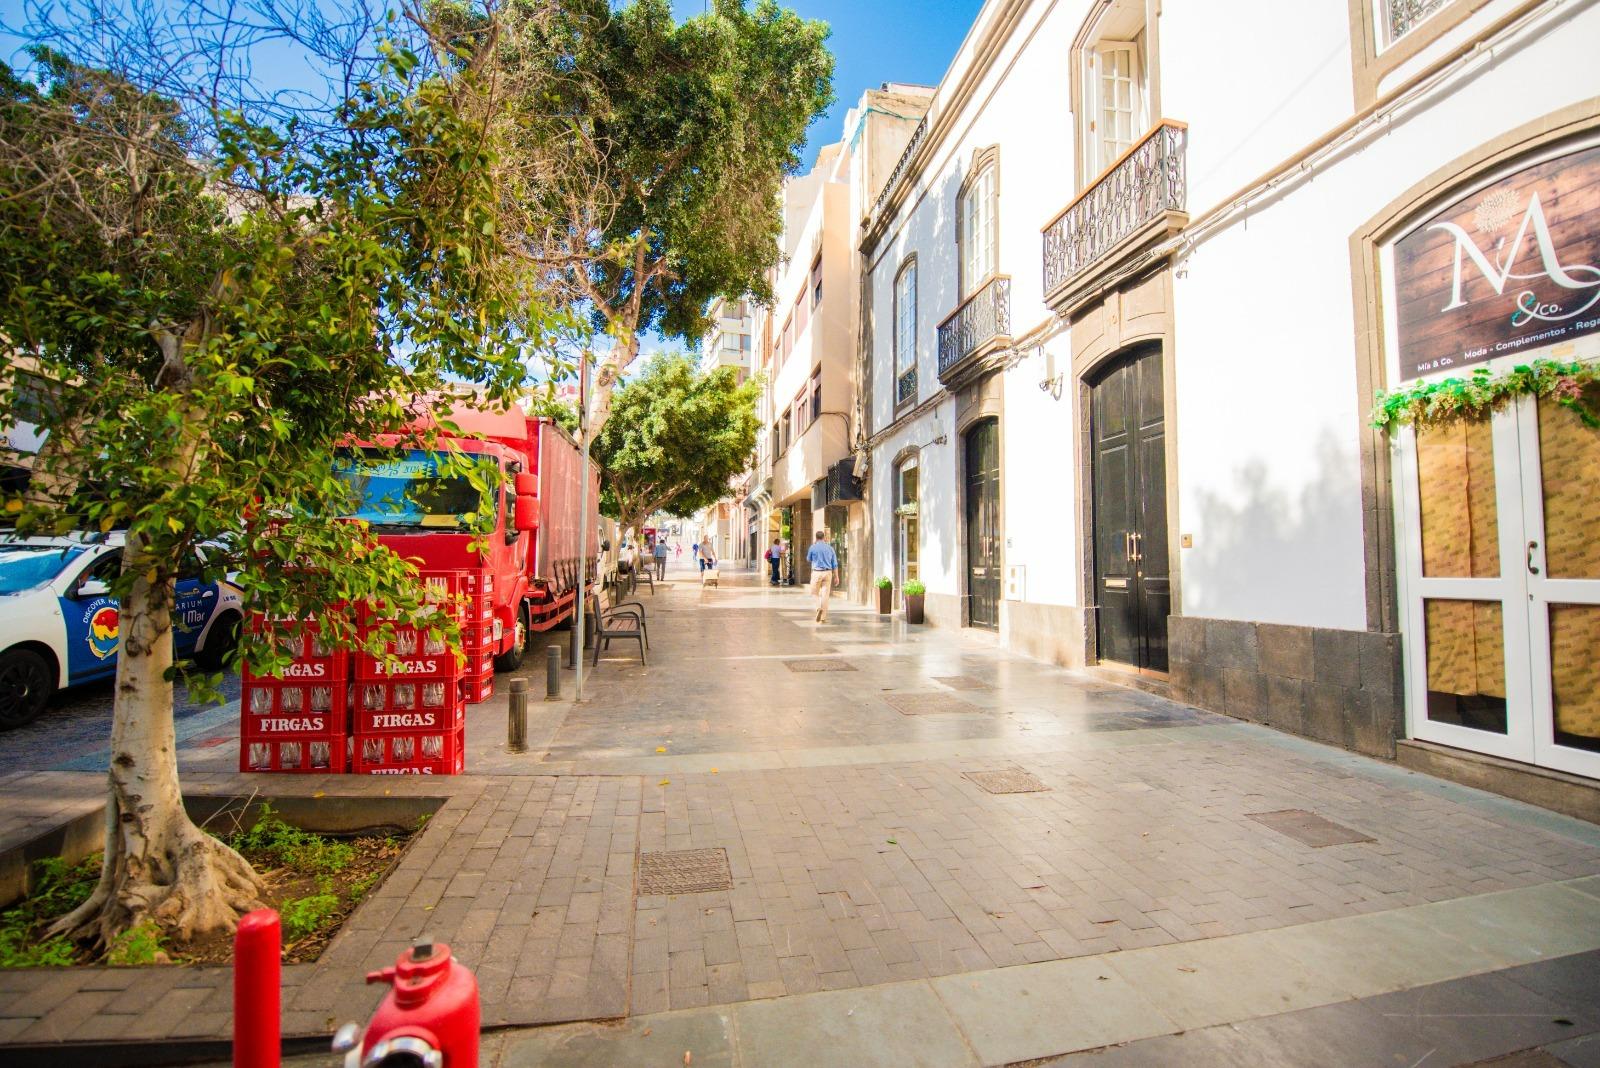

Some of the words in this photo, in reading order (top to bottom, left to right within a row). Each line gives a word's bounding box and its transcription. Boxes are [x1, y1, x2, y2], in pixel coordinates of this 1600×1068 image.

[1464, 348, 1488, 359] Moda
[1495, 327, 1566, 350] Complementos
[82, 598, 106, 624] DISCOVER
[187, 610, 206, 624] Mar
[260, 718, 324, 732] FIRGAS
[373, 713, 435, 728] FIRGAS
